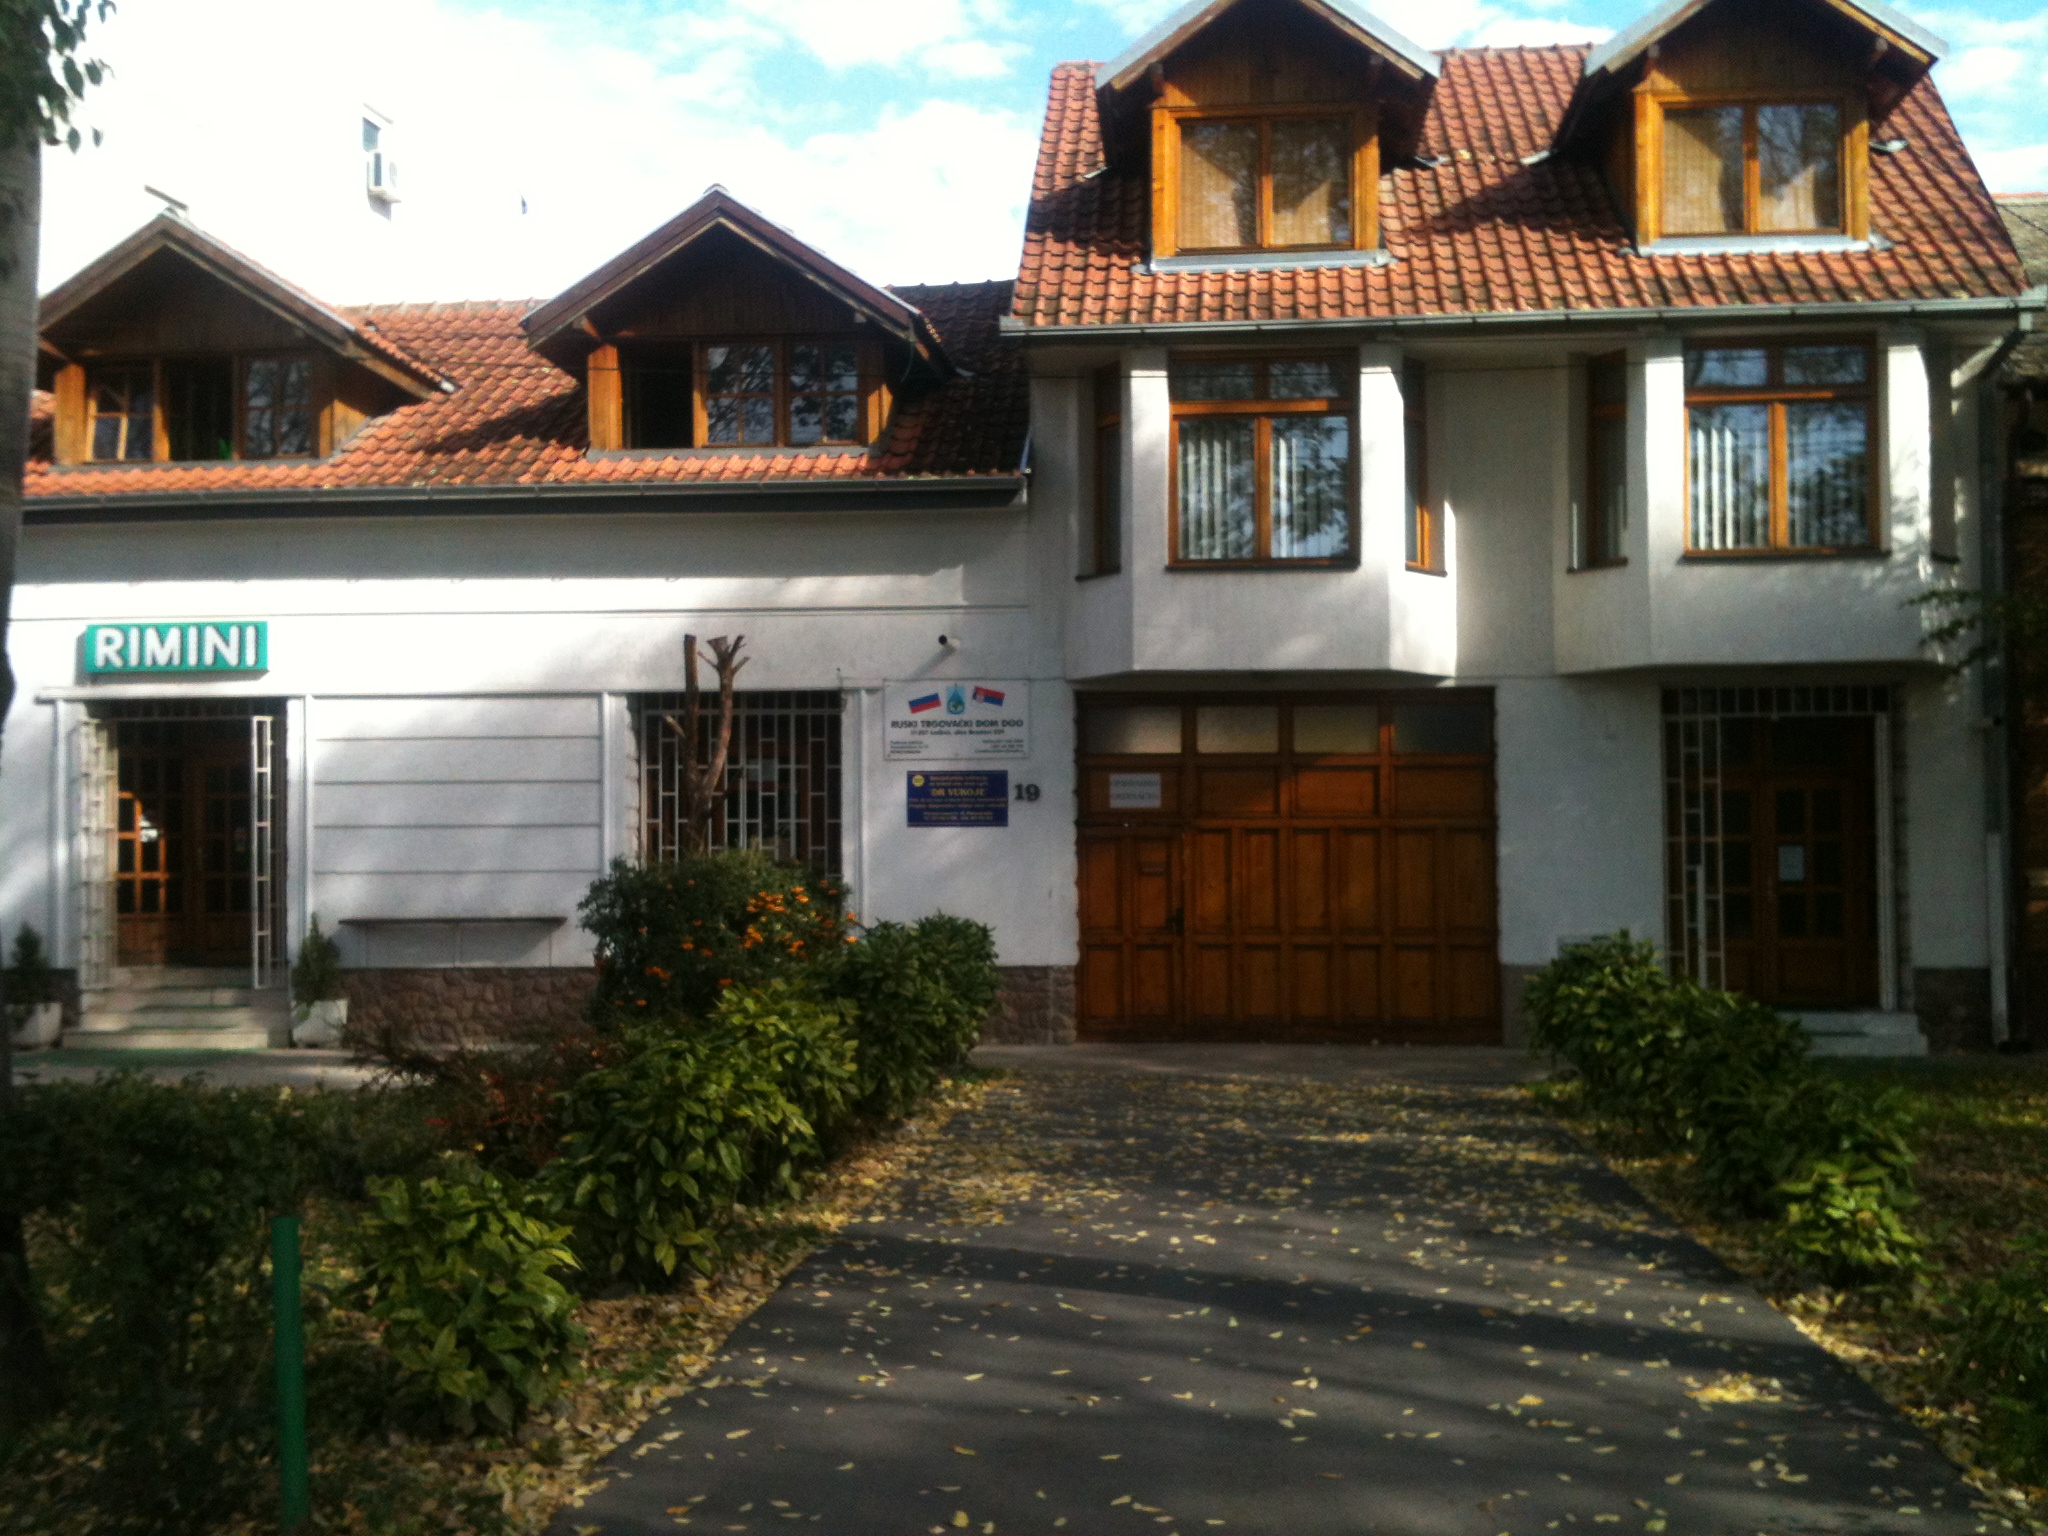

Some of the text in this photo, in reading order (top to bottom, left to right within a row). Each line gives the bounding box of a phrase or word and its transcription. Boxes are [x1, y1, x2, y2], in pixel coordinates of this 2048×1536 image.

[94, 624, 257, 668] RIMINI
[890, 719, 918, 728] RUSKI
[975, 719, 999, 728] DOM
[1001, 719, 1024, 727] DOO
[1014, 783, 1041, 802] 19
